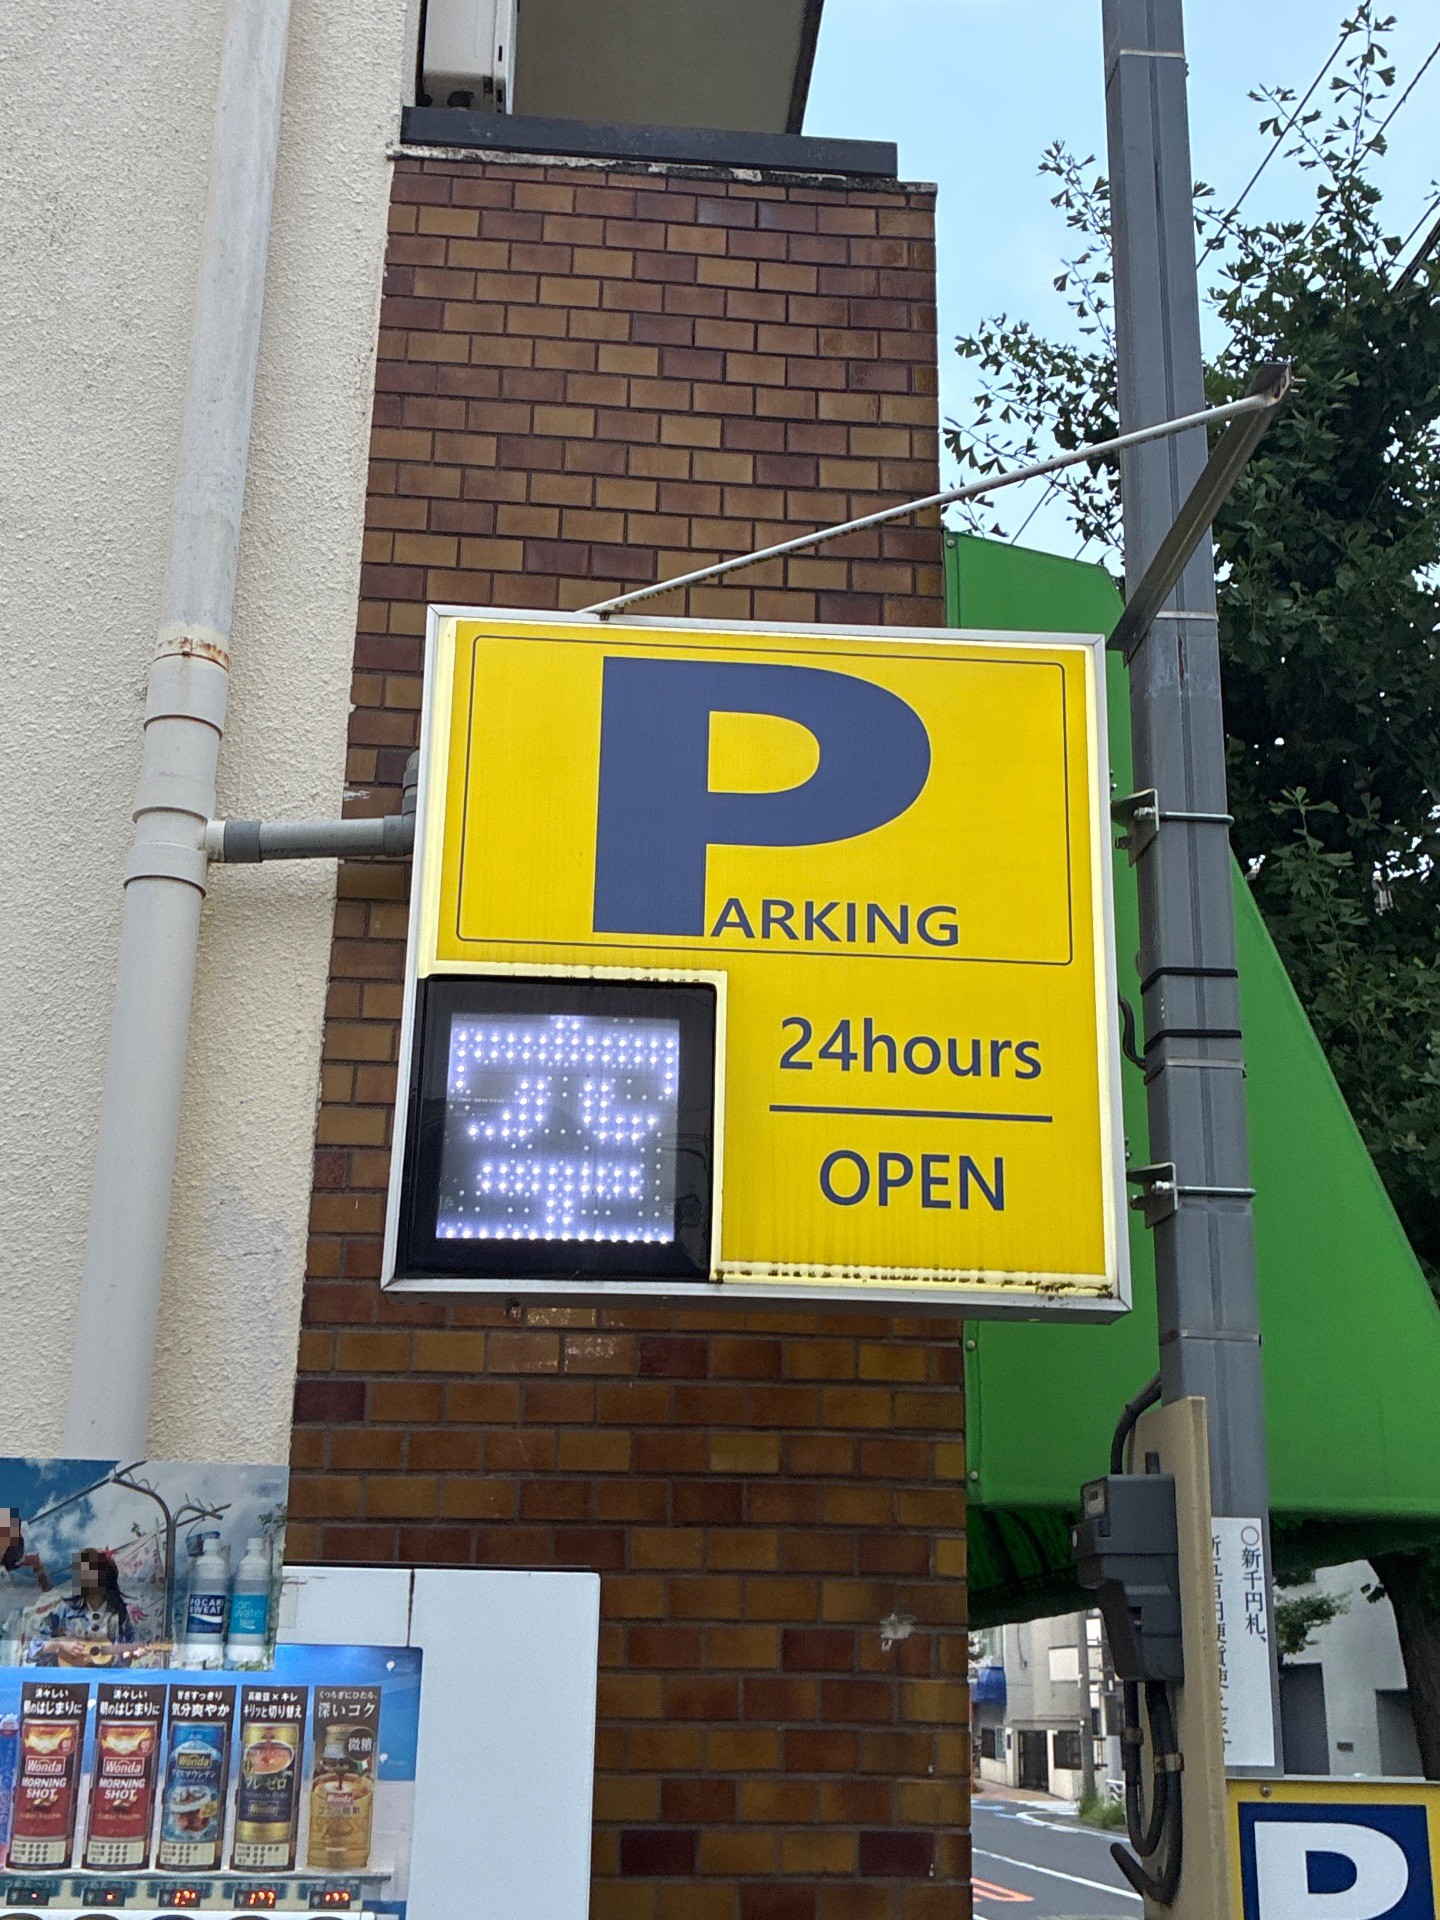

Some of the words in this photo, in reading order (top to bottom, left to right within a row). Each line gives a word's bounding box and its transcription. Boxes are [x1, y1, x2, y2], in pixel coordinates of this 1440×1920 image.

[779, 1014, 1042, 1080] 24hours
[438, 1016, 677, 1243] 空
[819, 1149, 1006, 1212] OPEN
[318, 1701, 376, 1719] 深いコク
[27, 1759, 62, 1773] Wonda
[105, 1760, 141, 1774] Wonda
[21, 1777, 67, 1788] MORNING
[98, 1777, 146, 1789] MORNING
[26, 1788, 58, 1799] SHOT
[104, 1789, 136, 1799] SHOT
[1253, 1820, 1409, 1920] P
